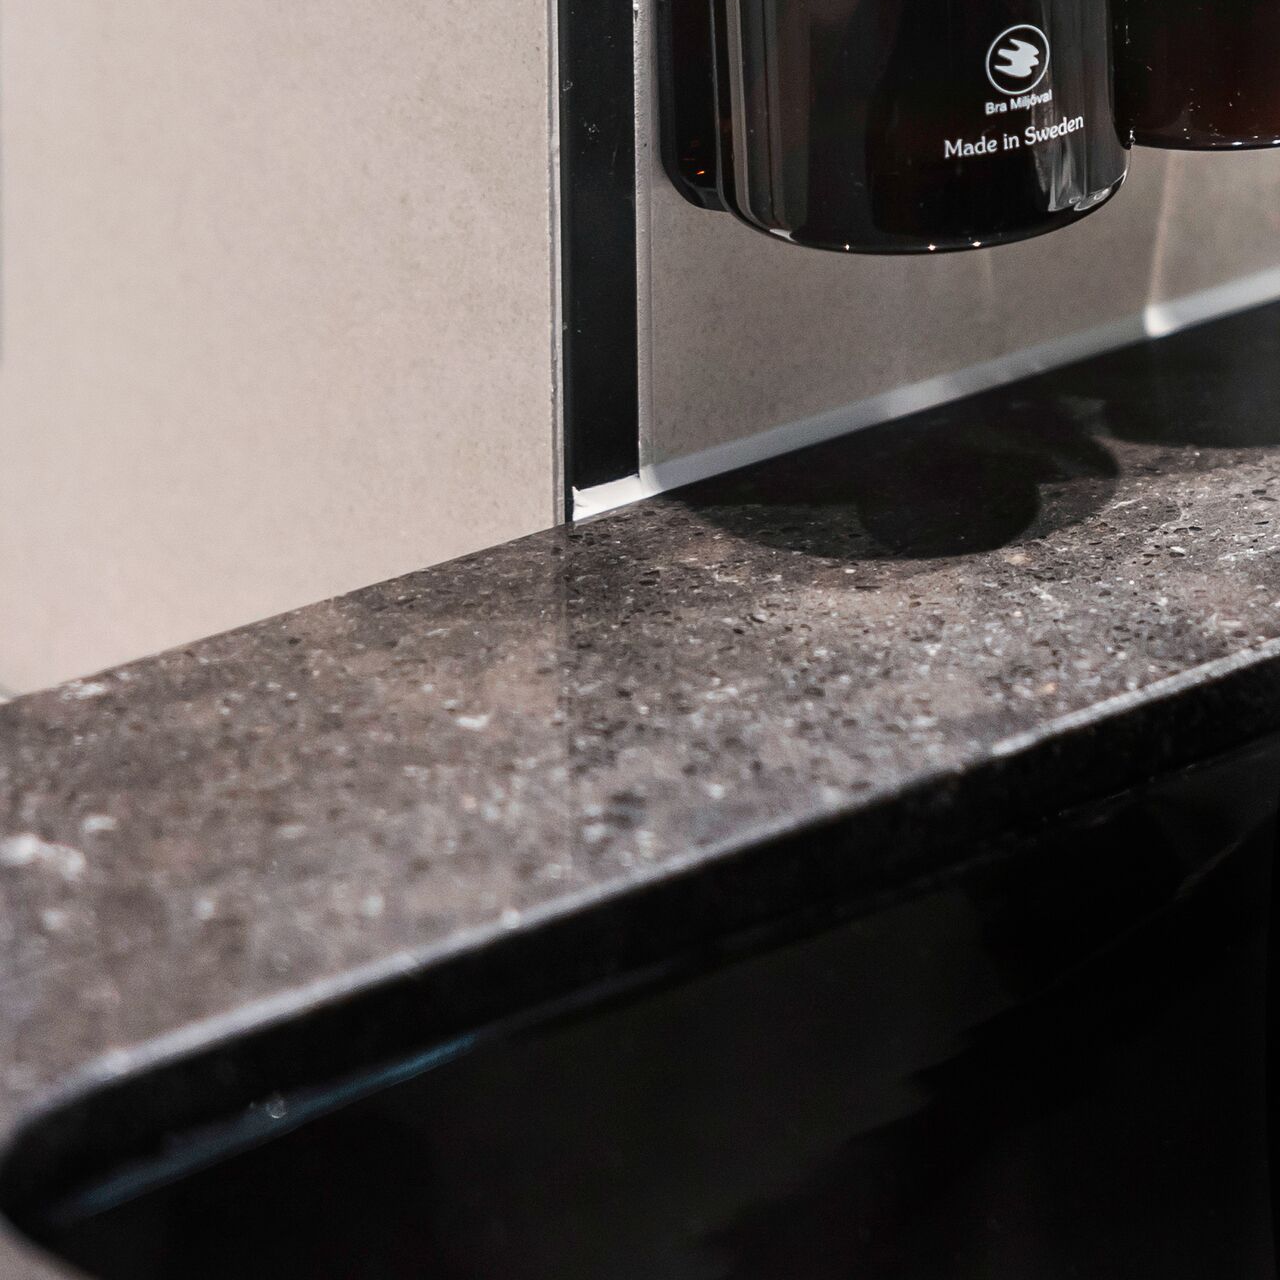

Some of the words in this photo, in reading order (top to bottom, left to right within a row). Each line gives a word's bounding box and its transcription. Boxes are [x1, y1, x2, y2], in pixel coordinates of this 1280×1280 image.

[985, 101, 1008, 116] Bra
[944, 134, 999, 160] Made
[1003, 133, 1020, 151] in
[1024, 114, 1085, 147] Sweden
